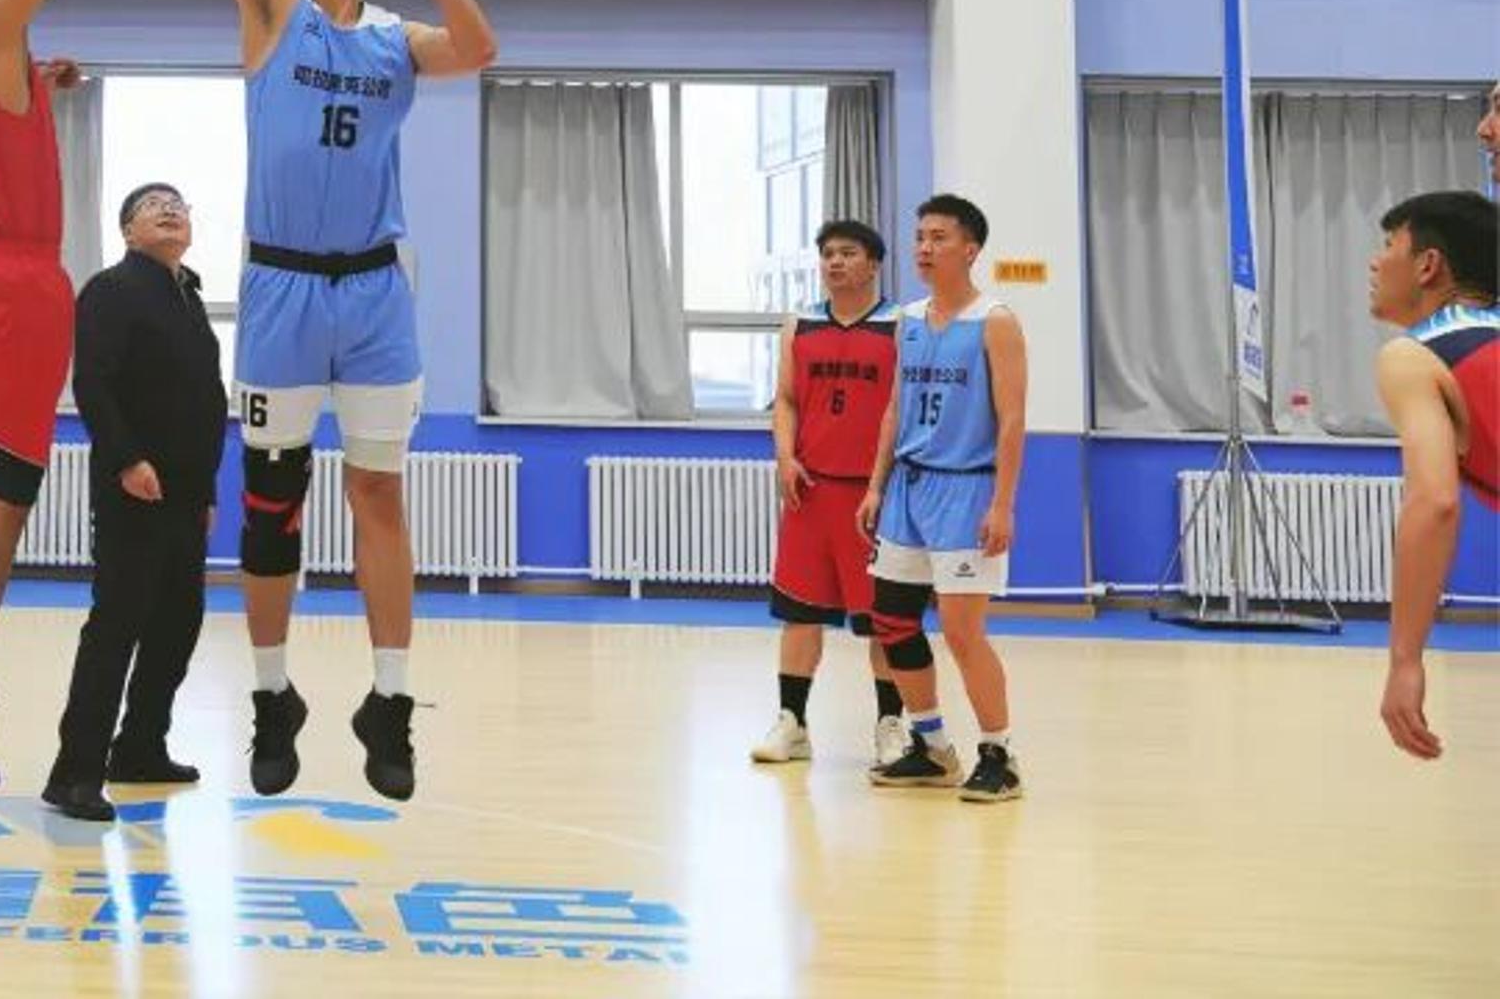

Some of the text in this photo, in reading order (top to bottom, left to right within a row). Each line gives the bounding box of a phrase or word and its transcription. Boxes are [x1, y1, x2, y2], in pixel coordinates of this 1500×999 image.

[320, 105, 359, 148] 16
[241, 391, 267, 428] 16
[918, 392, 942, 426] 15
